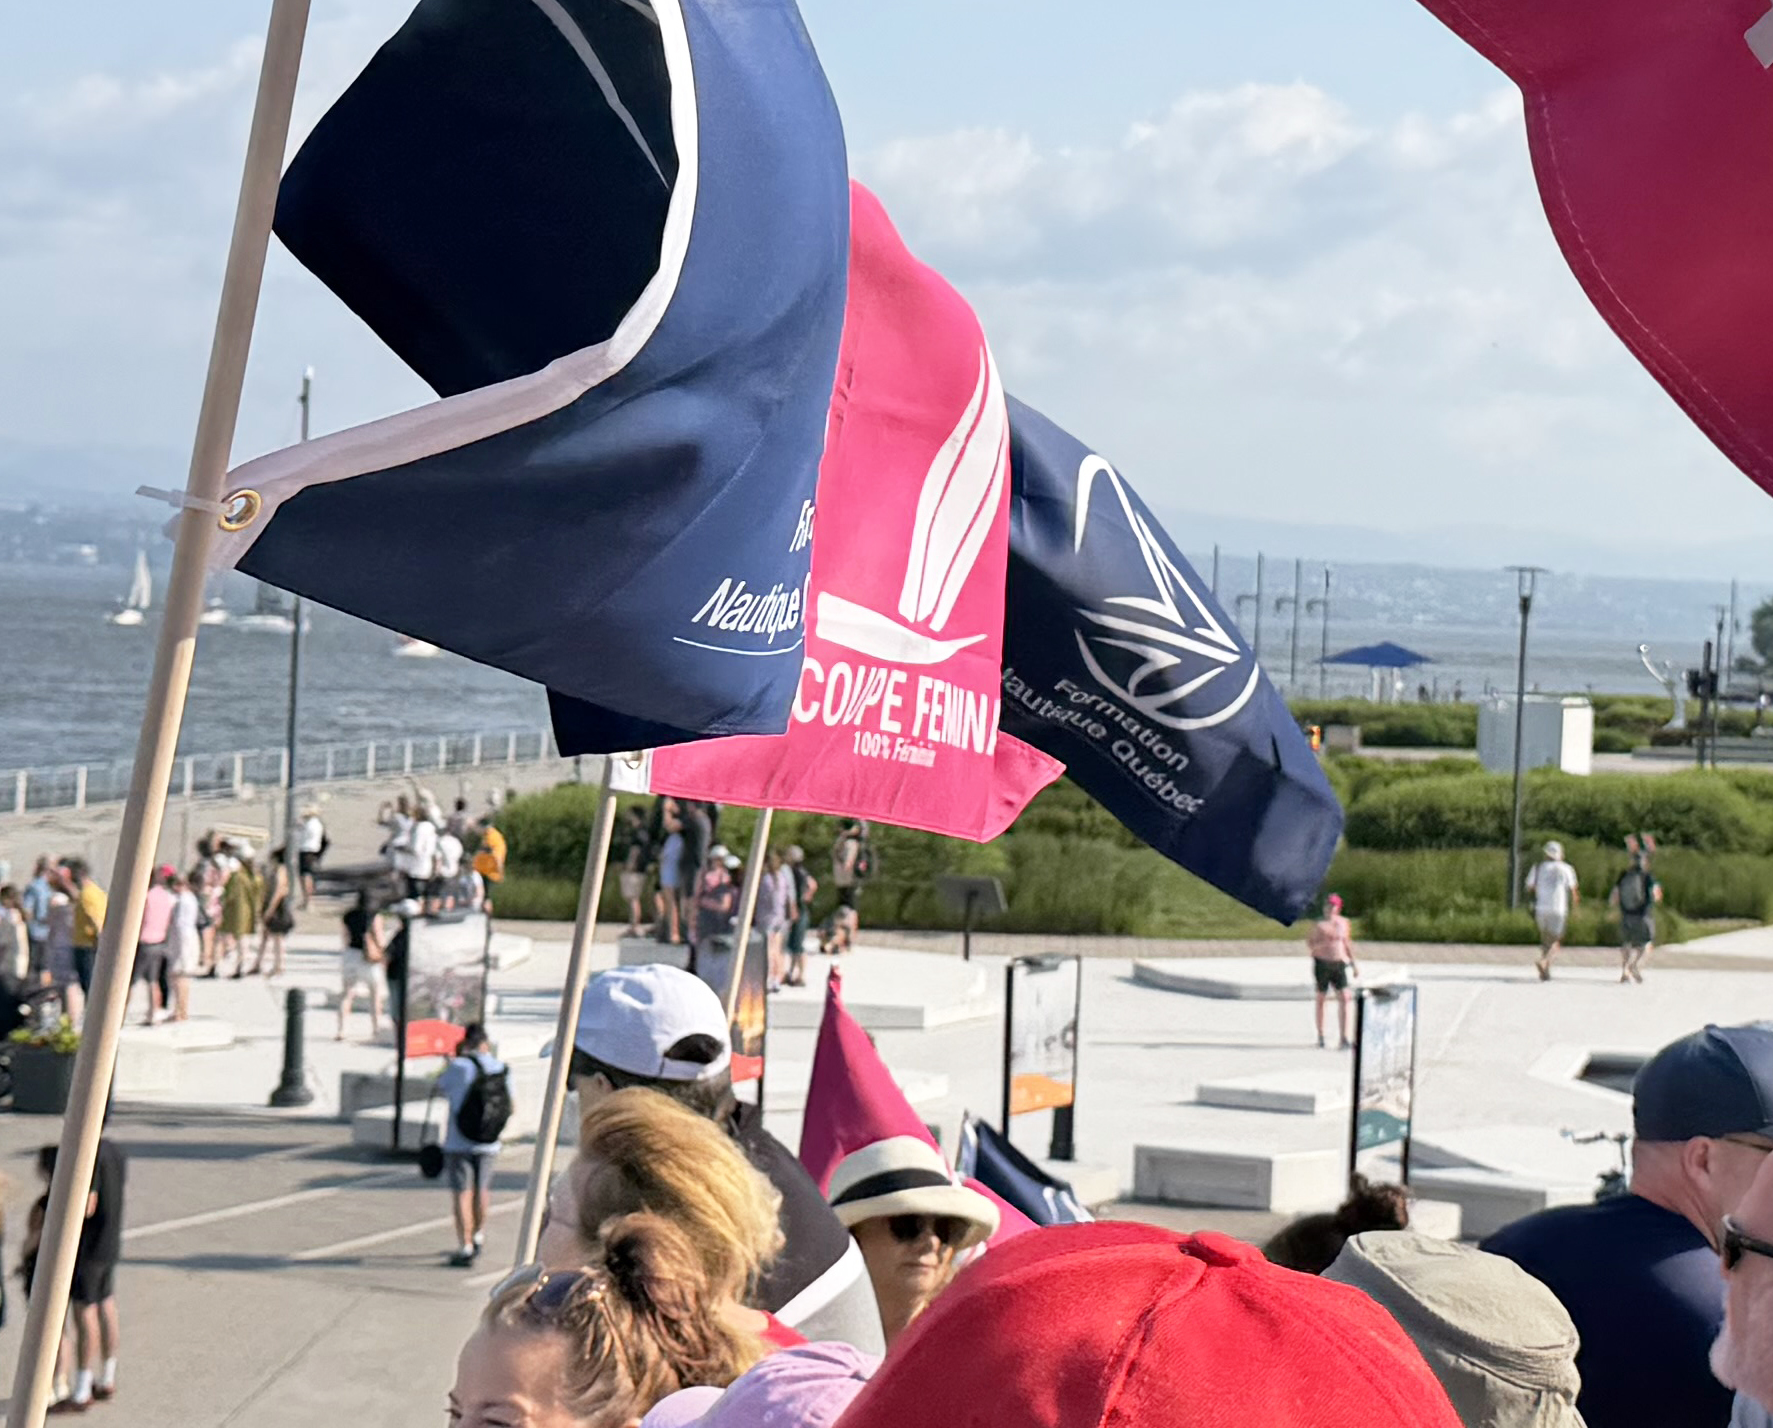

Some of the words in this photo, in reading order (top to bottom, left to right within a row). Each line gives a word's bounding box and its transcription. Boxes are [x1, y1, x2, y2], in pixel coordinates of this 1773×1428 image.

[691, 578, 800, 644] Nautique
[792, 657, 907, 734] COUPE
[1054, 678, 1189, 771] Formation
[1112, 740, 1204, 812] Québec
